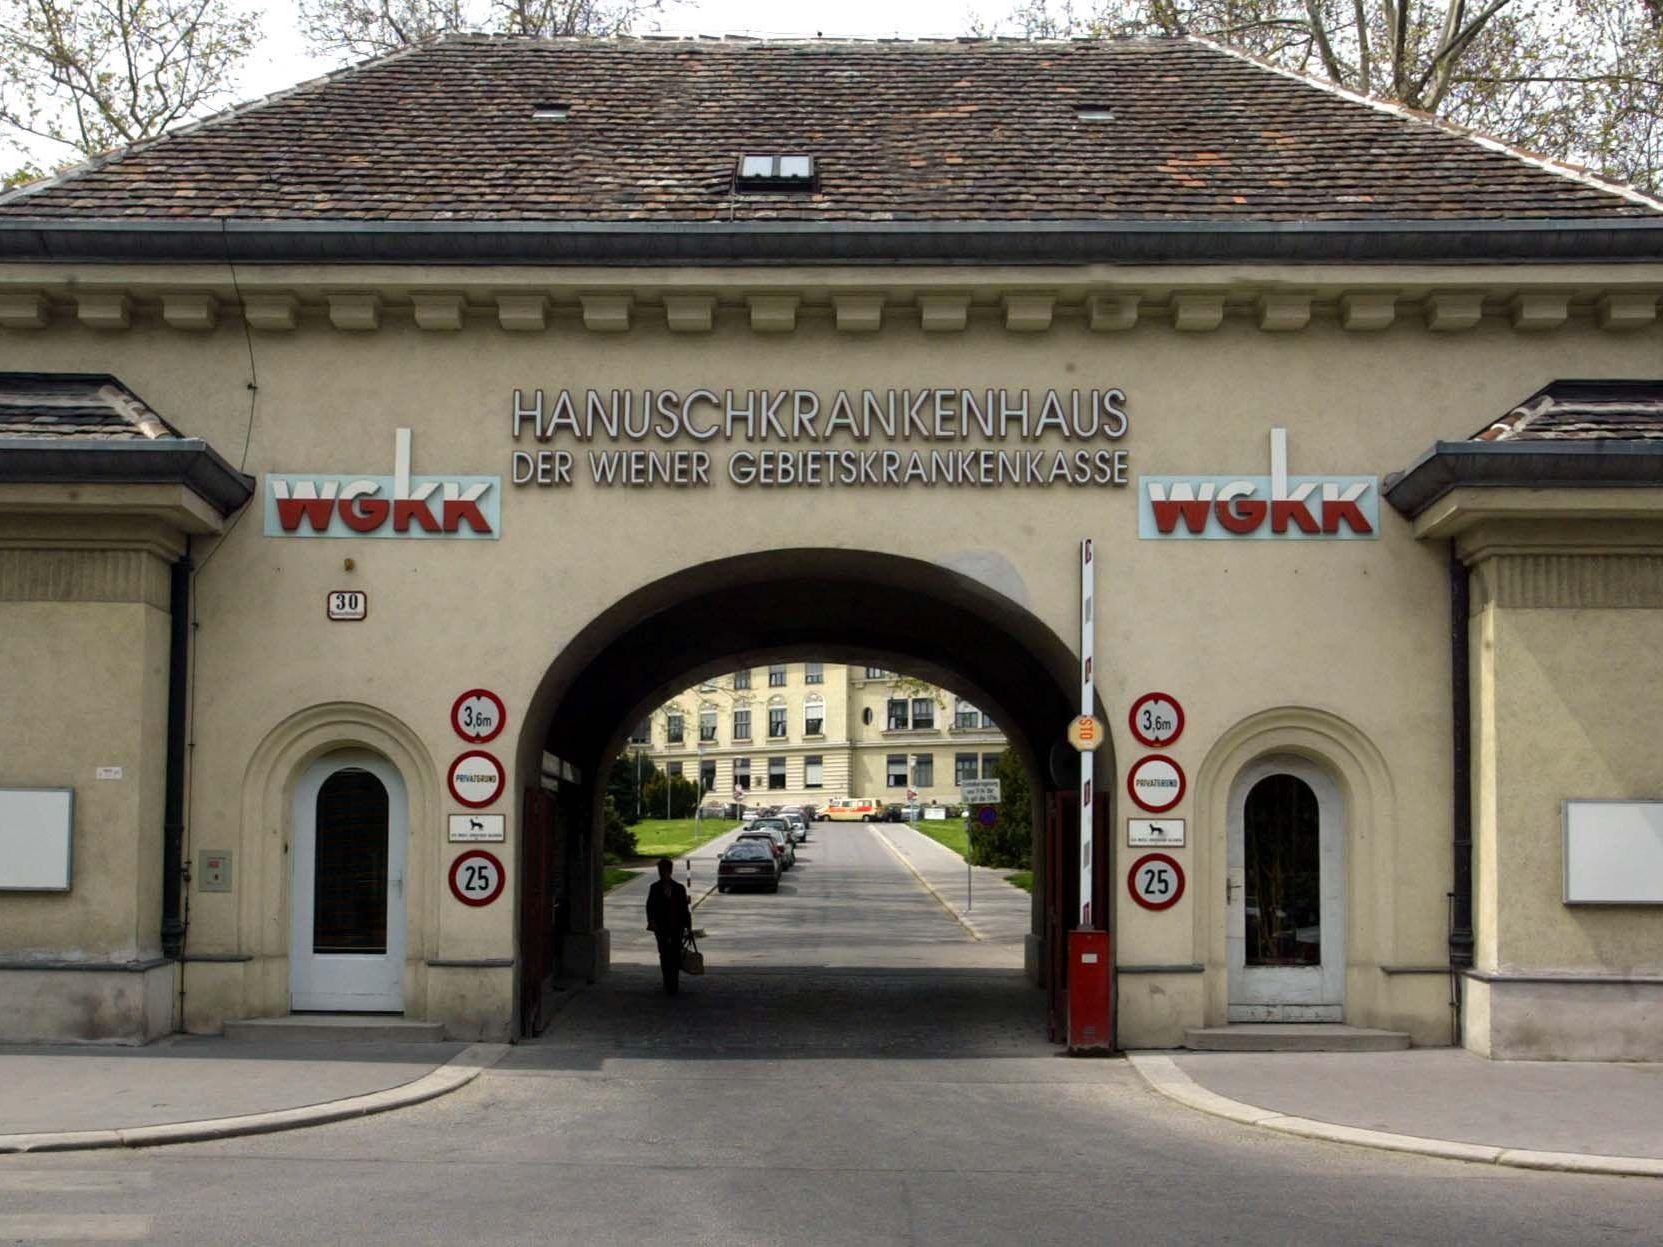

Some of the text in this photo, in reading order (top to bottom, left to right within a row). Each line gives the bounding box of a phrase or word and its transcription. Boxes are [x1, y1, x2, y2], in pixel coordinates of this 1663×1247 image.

[512, 388, 1129, 440] HANUSCHKRANKENHAUS
[272, 427, 493, 534] WGKK
[512, 450, 1129, 486] DER WIENER GEBIETSKRANKENKASSE
[1148, 427, 1374, 534] WGKK
[335, 593, 359, 610] 30
[463, 706, 492, 729] 3,6m
[1142, 709, 1172, 733] 3,6m
[464, 866, 489, 891] 25
[1144, 869, 1169, 895] 25
